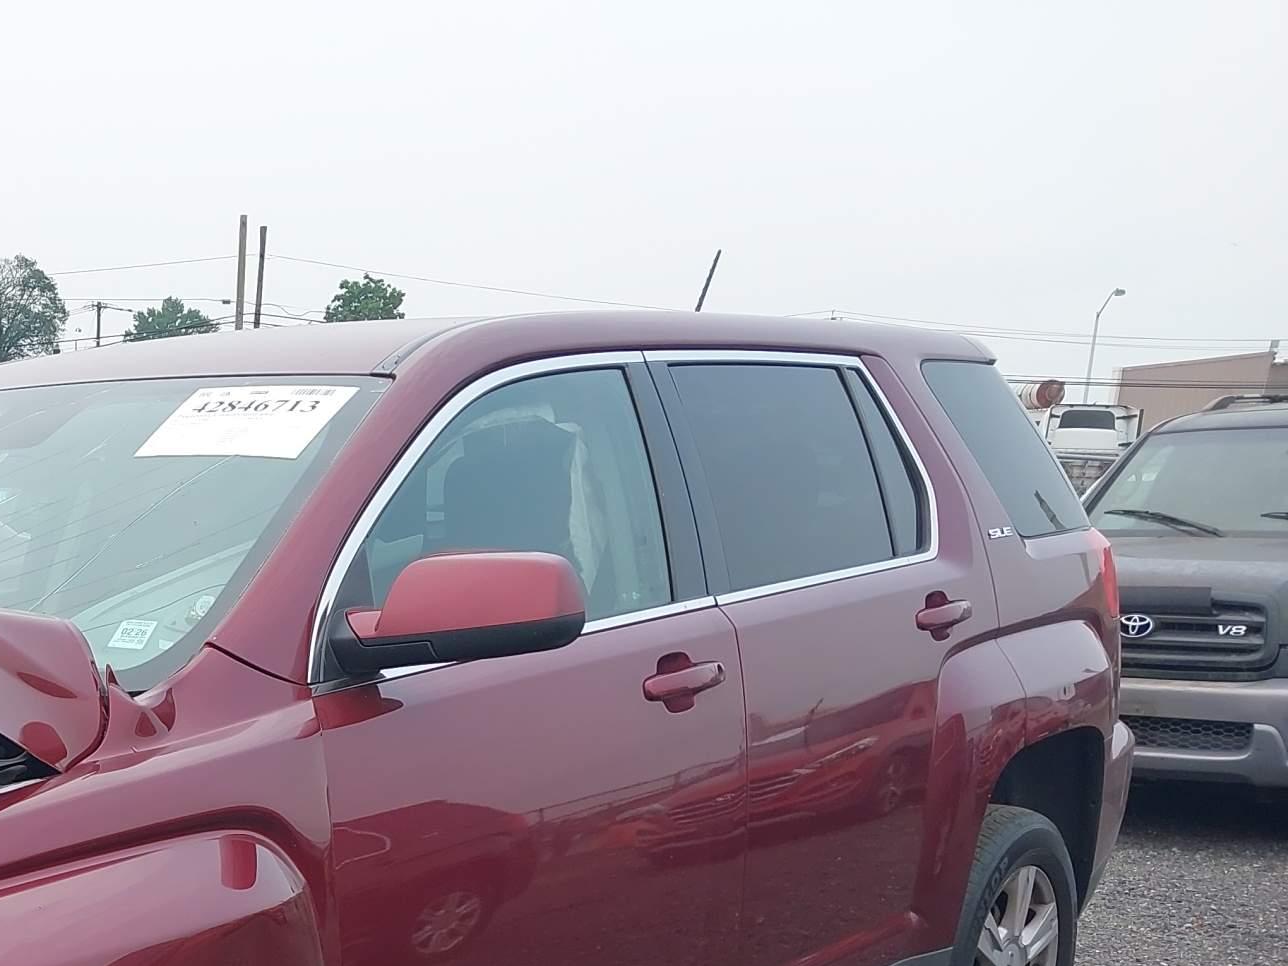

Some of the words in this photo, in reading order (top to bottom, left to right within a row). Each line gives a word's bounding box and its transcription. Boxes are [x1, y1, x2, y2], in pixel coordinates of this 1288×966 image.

[192, 400, 320, 413] 42846713
[988, 526, 1013, 539] SLE
[121, 627, 134, 636] 02
[1218, 624, 1248, 636] V8
